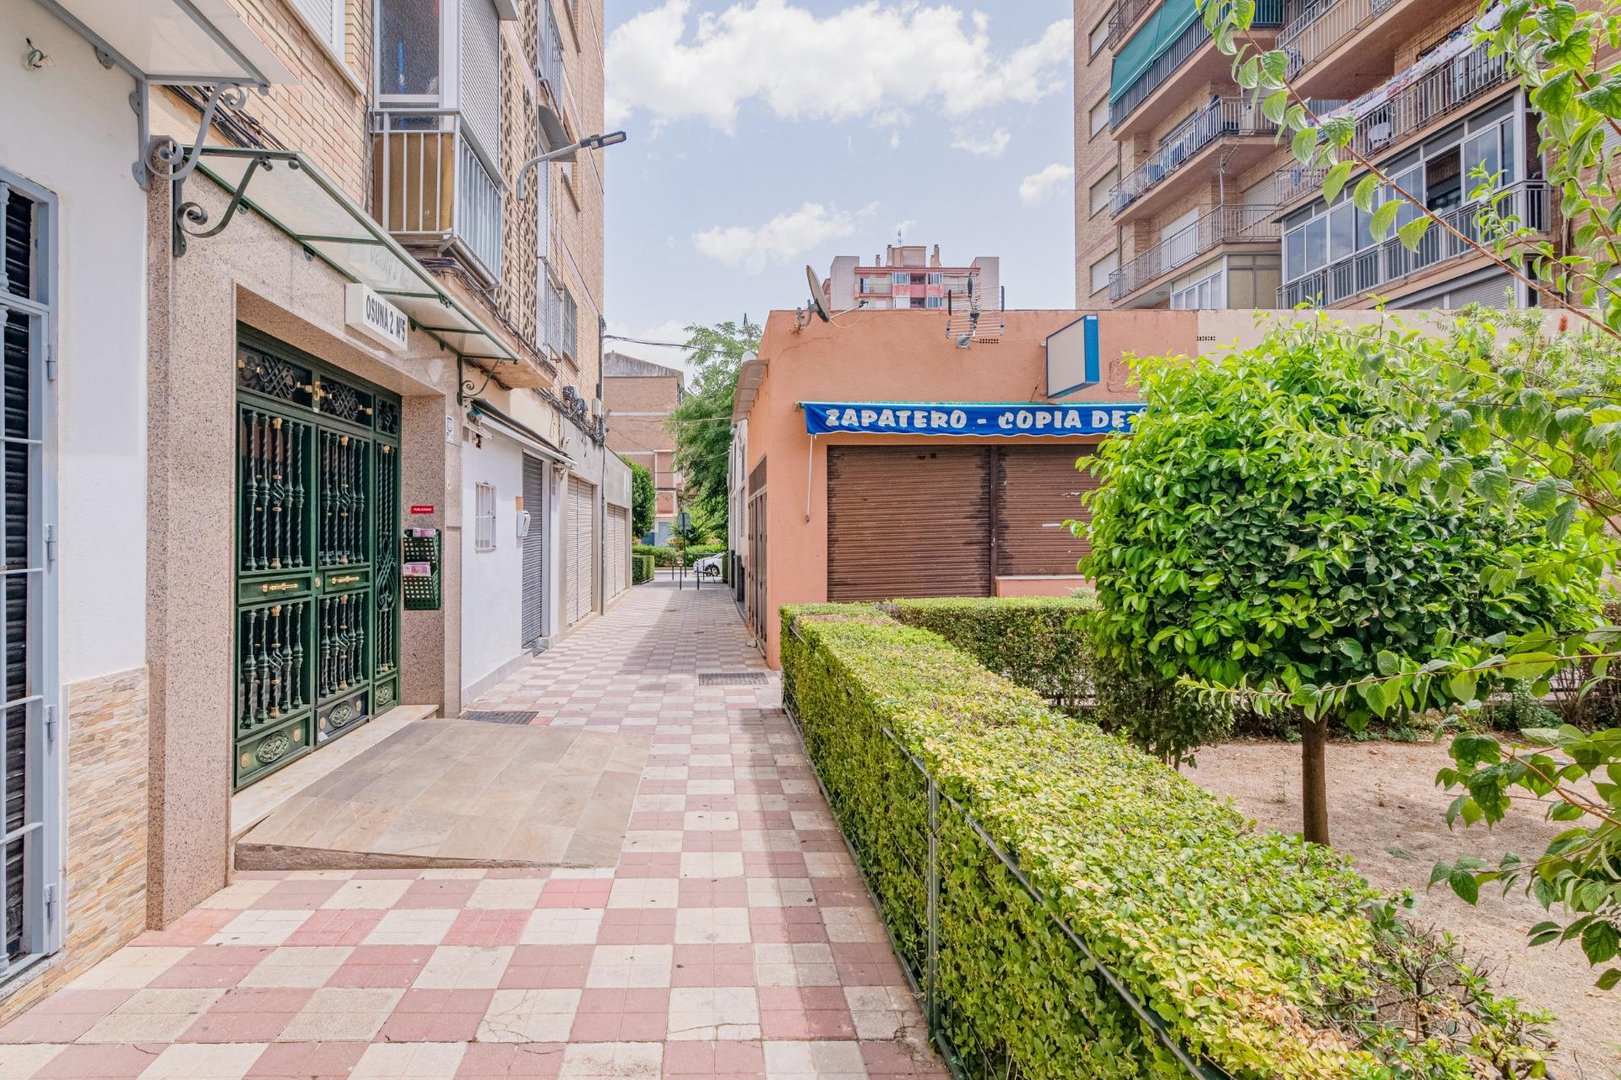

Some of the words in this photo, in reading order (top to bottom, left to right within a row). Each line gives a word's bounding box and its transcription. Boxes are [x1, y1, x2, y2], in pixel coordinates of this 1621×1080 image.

[366, 294, 389, 332] OSUNA
[389, 310, 394, 334] 2
[825, 408, 967, 429] ZAPATERO
[998, 409, 1082, 429] COPIA
[1092, 410, 1127, 428] DE
